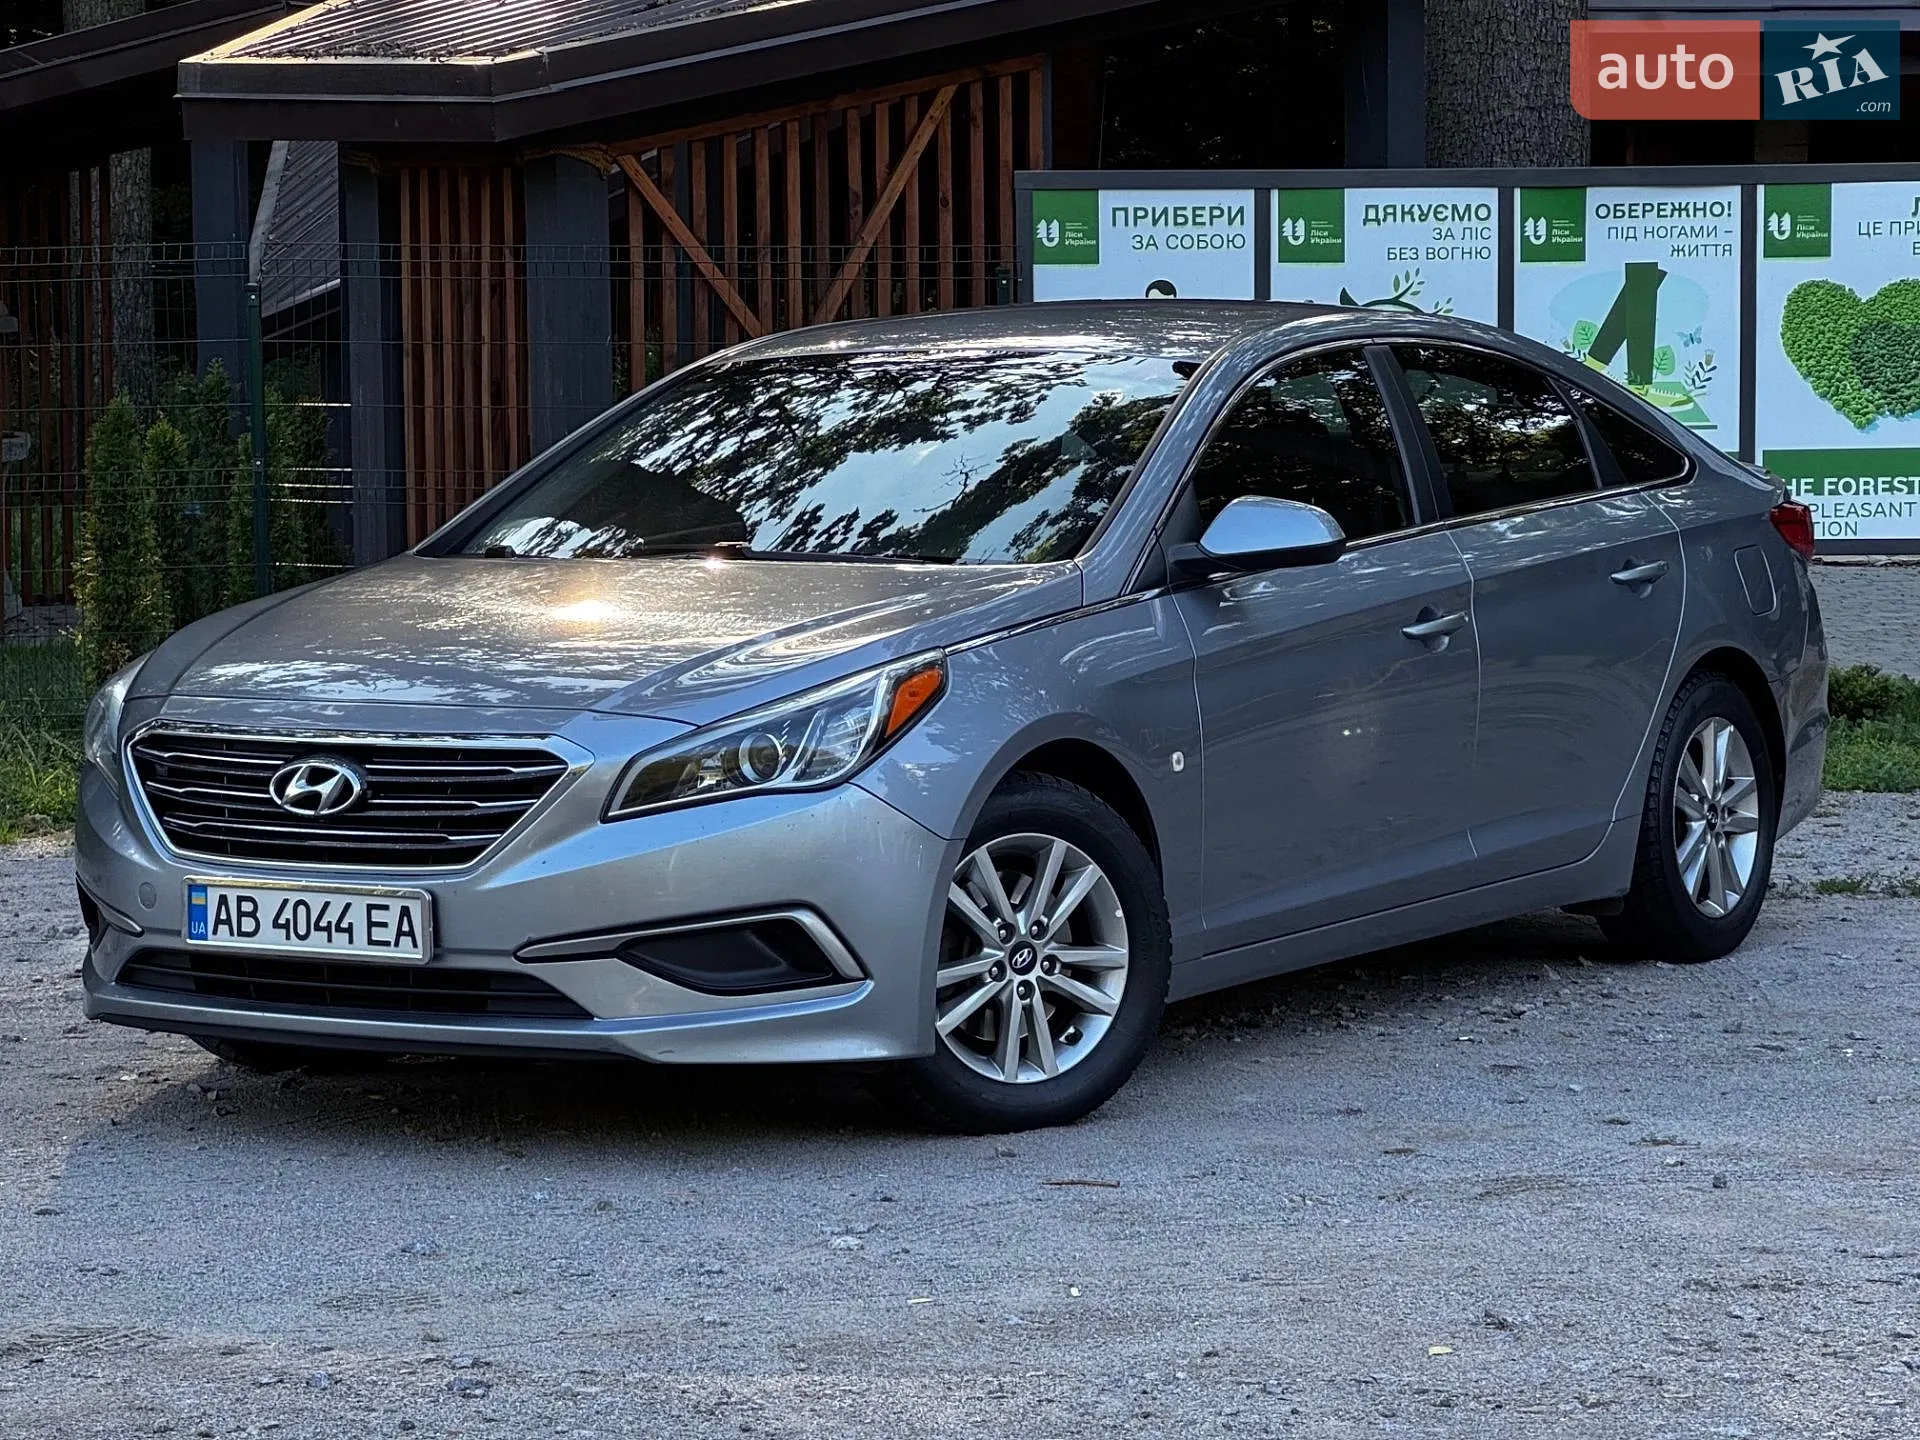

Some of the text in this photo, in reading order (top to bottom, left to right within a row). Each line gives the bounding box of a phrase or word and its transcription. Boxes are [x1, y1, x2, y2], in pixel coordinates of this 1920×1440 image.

[1112, 205, 1245, 227] ПРИБЕРИ
[1362, 203, 1492, 226] ДЯКУЄМО
[1595, 201, 1732, 219] ОБЕРЕЖНО!
[1432, 226, 1492, 241] ЗА ЛІС
[1607, 226, 1638, 242] ПІД
[1644, 225, 1718, 239] НОГАМИ
[1858, 220, 1920, 239] ЦЕ ПР
[1131, 233, 1246, 250] ЗА СОБОЮ
[1387, 246, 1491, 261] БЕЗ ВОГНЮ
[1670, 244, 1733, 257] ЖИТТЯ
[1782, 476, 1920, 496] HE FOREST
[191, 920, 207, 935] UA
[211, 893, 419, 949] AB 4044 EA
